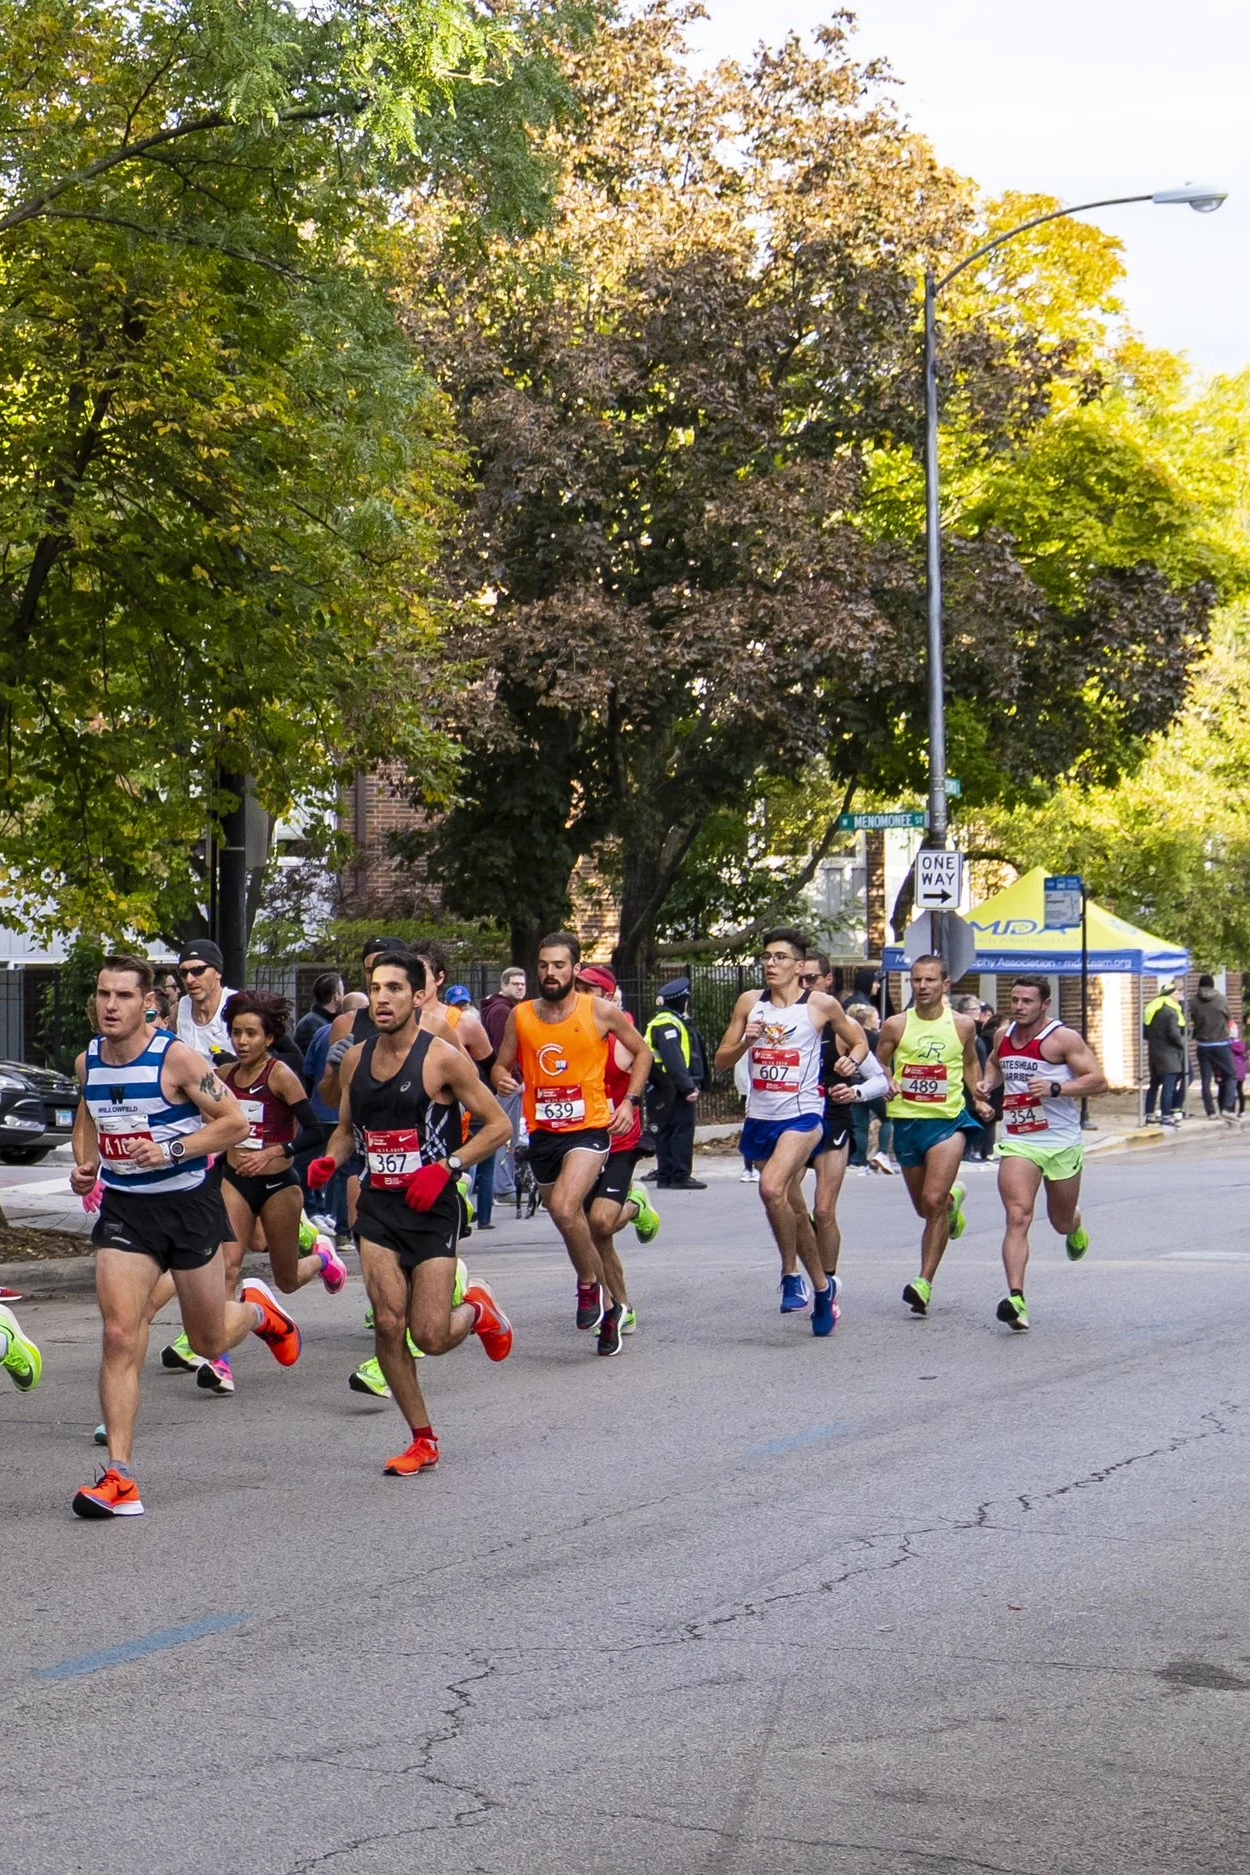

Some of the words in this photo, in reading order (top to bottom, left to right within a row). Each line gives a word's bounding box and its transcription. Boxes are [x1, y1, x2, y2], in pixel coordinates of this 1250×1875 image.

[854, 814, 913, 828] MENOMONEE
[915, 815, 924, 824] ST
[922, 856, 955, 870] ONE
[921, 872, 955, 885] WAY
[996, 958, 1056, 968] Association
[1063, 957, 1132, 969] mdteam.org
[760, 1066, 789, 1080] 607
[1005, 1073, 1035, 1081] ARRIE
[909, 1080, 938, 1093] 489
[98, 1105, 138, 1113] WILLOWFIELD
[544, 1103, 574, 1118] 639
[1010, 1108, 1036, 1124] 354
[105, 1137, 114, 1155] A
[376, 1154, 407, 1173] 367
